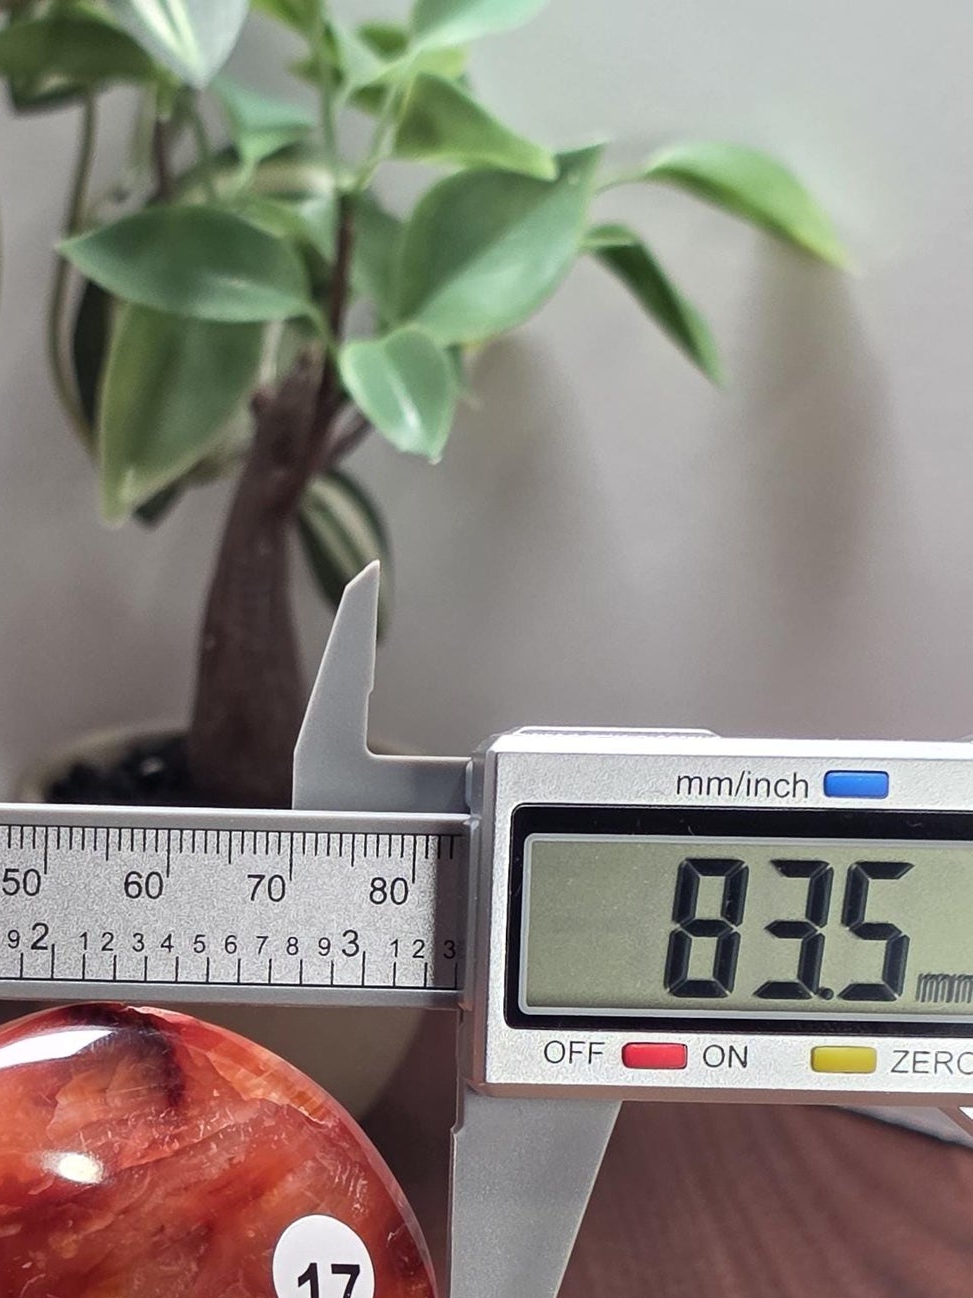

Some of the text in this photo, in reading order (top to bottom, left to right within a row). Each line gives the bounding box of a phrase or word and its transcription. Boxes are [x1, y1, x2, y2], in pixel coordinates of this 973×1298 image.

[676, 771, 809, 798] mm/inch
[2, 868, 41, 896] 50
[124, 871, 163, 899] 60
[247, 874, 286, 902] 70
[369, 877, 409, 905] 80
[7, 929, 20, 949] 9
[31, 922, 49, 950] 2
[79, 931, 88, 950] 1
[101, 932, 114, 951] 2
[132, 933, 145, 952] 3
[160, 933, 174, 953] 4
[193, 934, 206, 953] 5
[224, 935, 237, 954] 6
[256, 936, 269, 955] 7
[286, 937, 299, 956] 8
[318, 937, 331, 956] 9
[342, 929, 359, 957] 3
[390, 939, 398, 958] 1
[412, 939, 425, 958] 2
[443, 940, 456, 959] 3
[663, 858, 915, 1002] 83.5
[543, 1041, 605, 1064] OFF
[702, 1045, 748, 1068] ON
